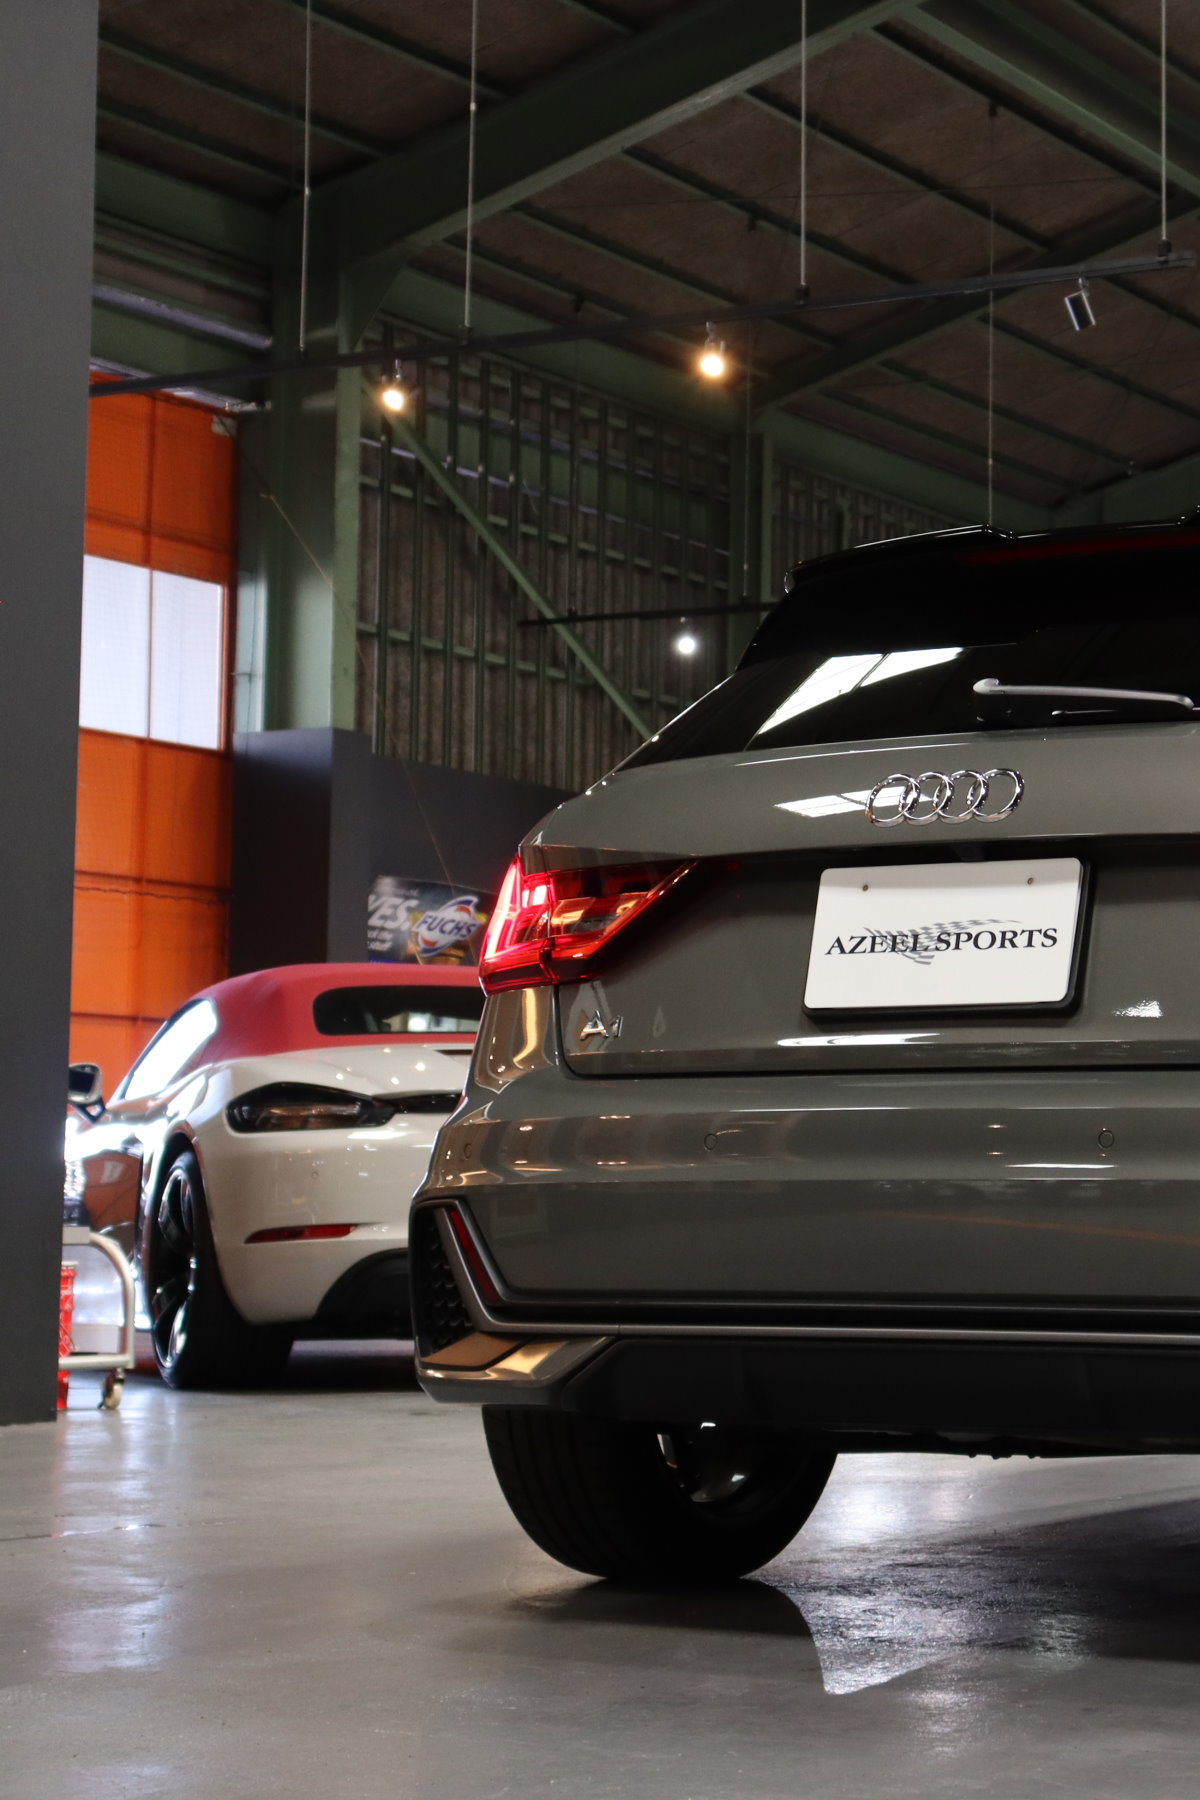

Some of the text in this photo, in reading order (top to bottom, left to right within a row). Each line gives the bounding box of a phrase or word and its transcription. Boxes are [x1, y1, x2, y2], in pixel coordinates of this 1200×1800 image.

[419, 915, 477, 938] FUCHS
[825, 927, 1058, 956] AZEEL SPORTS
[580, 1009, 624, 1041] A1
